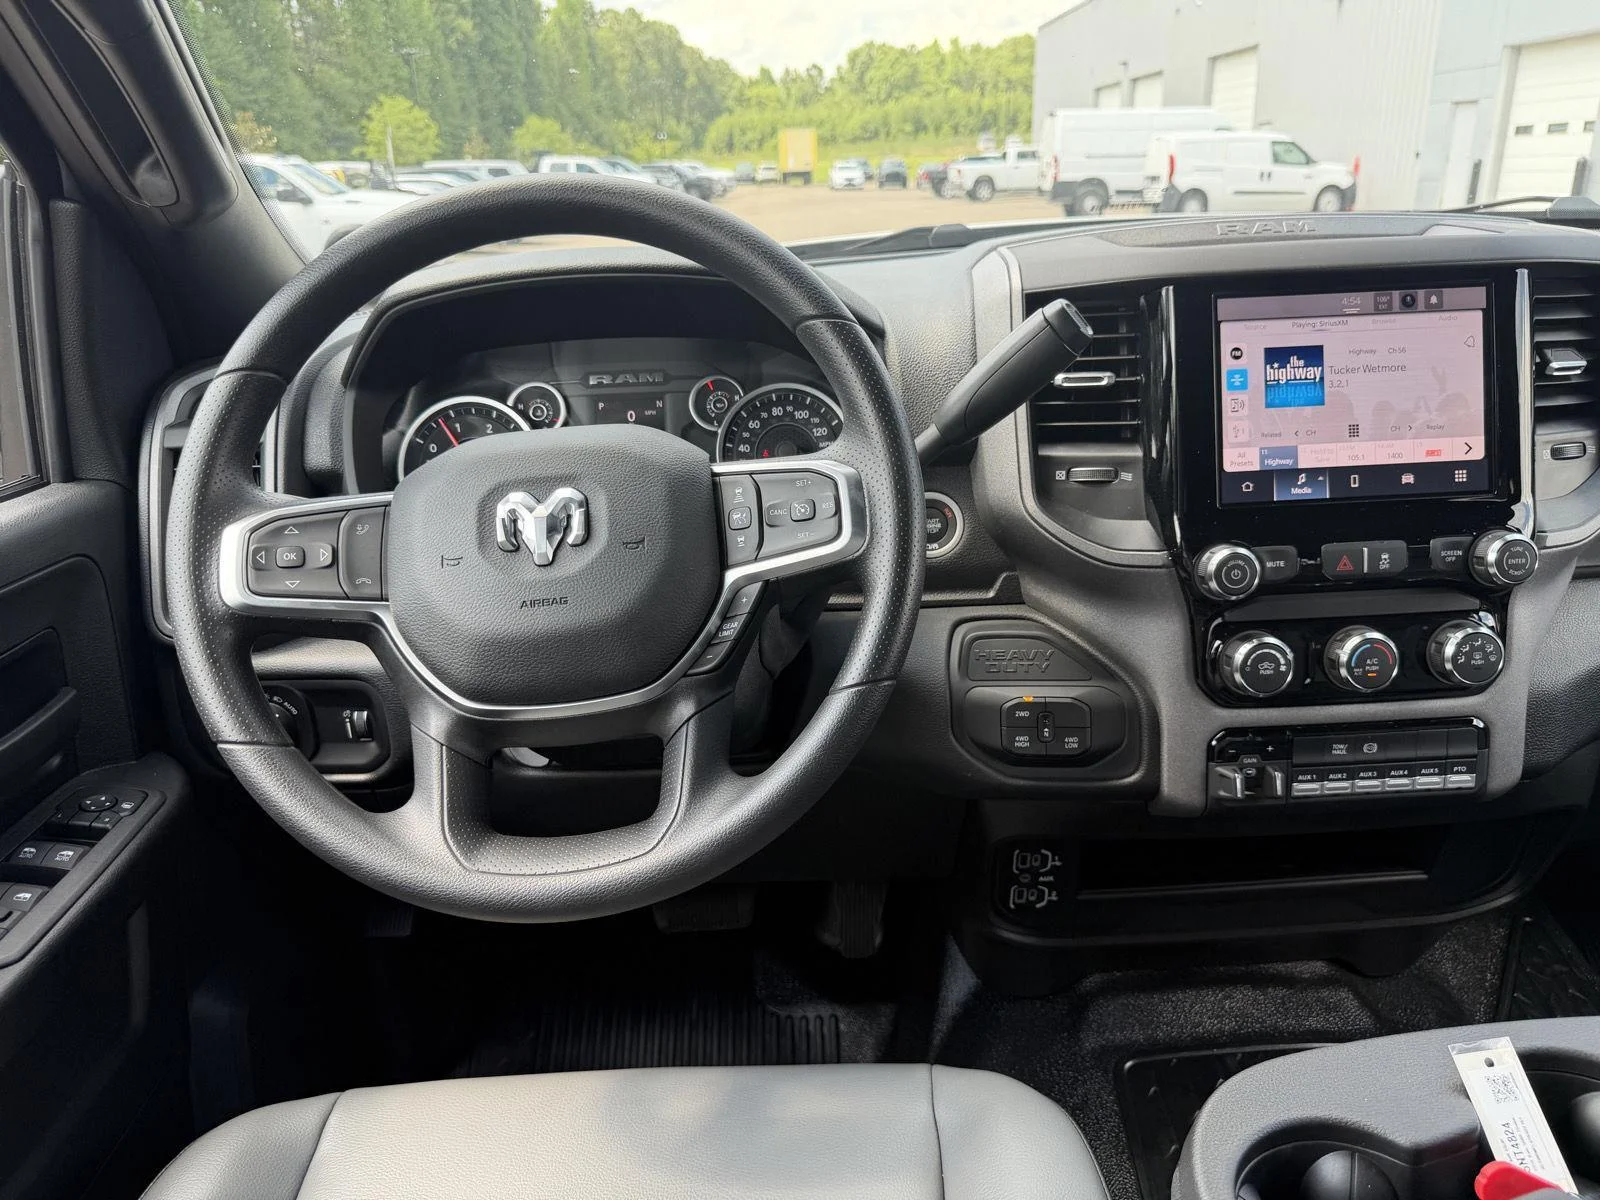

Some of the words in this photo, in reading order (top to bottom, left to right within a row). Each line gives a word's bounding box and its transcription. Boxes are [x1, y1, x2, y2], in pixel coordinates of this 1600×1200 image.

[1216, 220, 1317, 236] RAM
[1342, 297, 1361, 306] 4:54
[1438, 314, 1458, 322] Audio
[1291, 321, 1318, 329] Playing:
[1319, 319, 1349, 327] SiriusXM
[1348, 348, 1377, 356] Highway
[1290, 355, 1305, 367] the
[1266, 363, 1322, 384] highway
[1329, 365, 1361, 375] Tucker
[1362, 364, 1407, 373] Wetmore
[588, 373, 665, 385] RAM
[598, 402, 605, 411] P
[656, 400, 663, 408] N
[627, 410, 636, 422] 0
[760, 411, 768, 419] 70
[771, 407, 784, 416] 80
[794, 411, 810, 420] 100
[455, 423, 461, 433] 1
[486, 423, 494, 434] 2
[748, 420, 760, 429] 60
[1390, 424, 1401, 432] CH
[1426, 422, 1445, 431] Replay
[812, 428, 828, 437] 120
[1305, 428, 1317, 437] CH
[429, 443, 438, 453] 0
[738, 443, 751, 453] 40
[1387, 452, 1403, 460] 1400
[1230, 459, 1254, 467] Presets
[1264, 457, 1295, 467] Highway
[1291, 486, 1313, 495] Media
[769, 508, 788, 516] CANC
[283, 552, 297, 561] OK
[1266, 560, 1285, 568] MUTE
[520, 596, 569, 609] AIRBAG
[722, 622, 739, 630] GEAR
[718, 628, 734, 637] LIMIT
[974, 650, 1055, 661] HEAVY
[984, 662, 1051, 674] DUTY
[283, 701, 298, 715] AUTO
